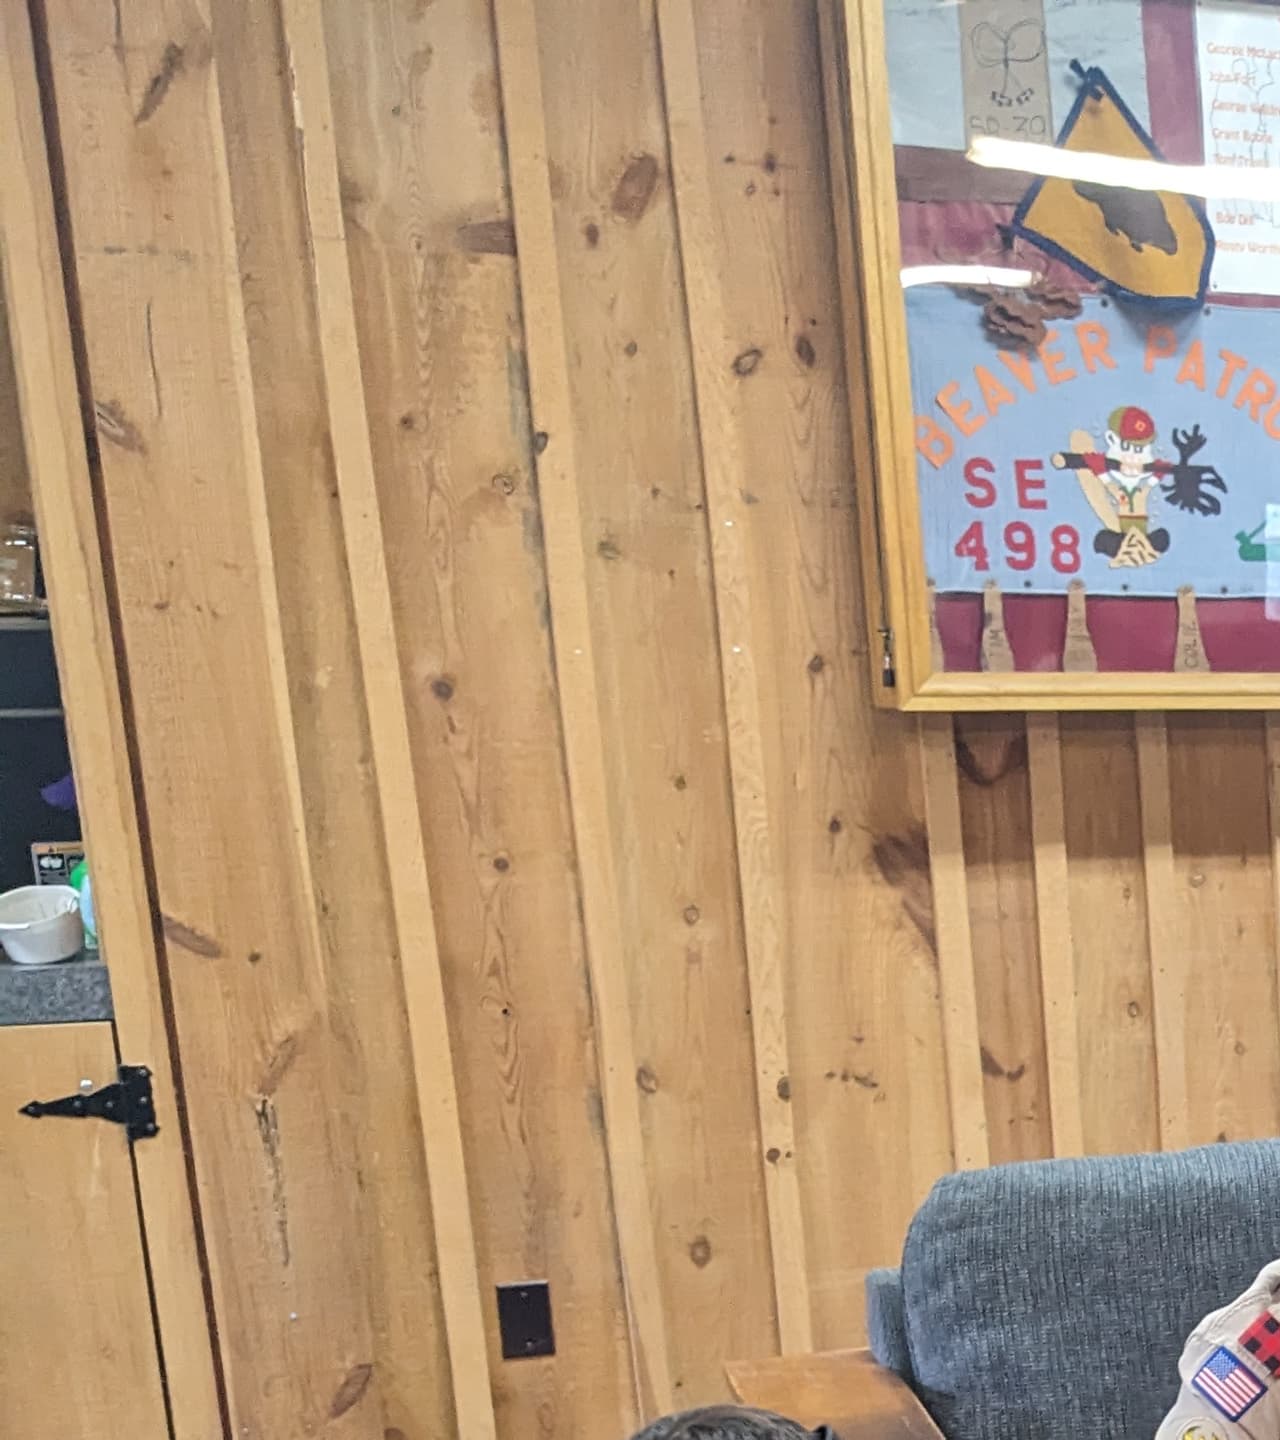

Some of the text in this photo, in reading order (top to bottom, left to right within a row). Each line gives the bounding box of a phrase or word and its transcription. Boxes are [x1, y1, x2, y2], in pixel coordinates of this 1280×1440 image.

[915, 320, 1118, 470] BEAVER
[963, 456, 1048, 511] SE
[954, 520, 1082, 575] 498
